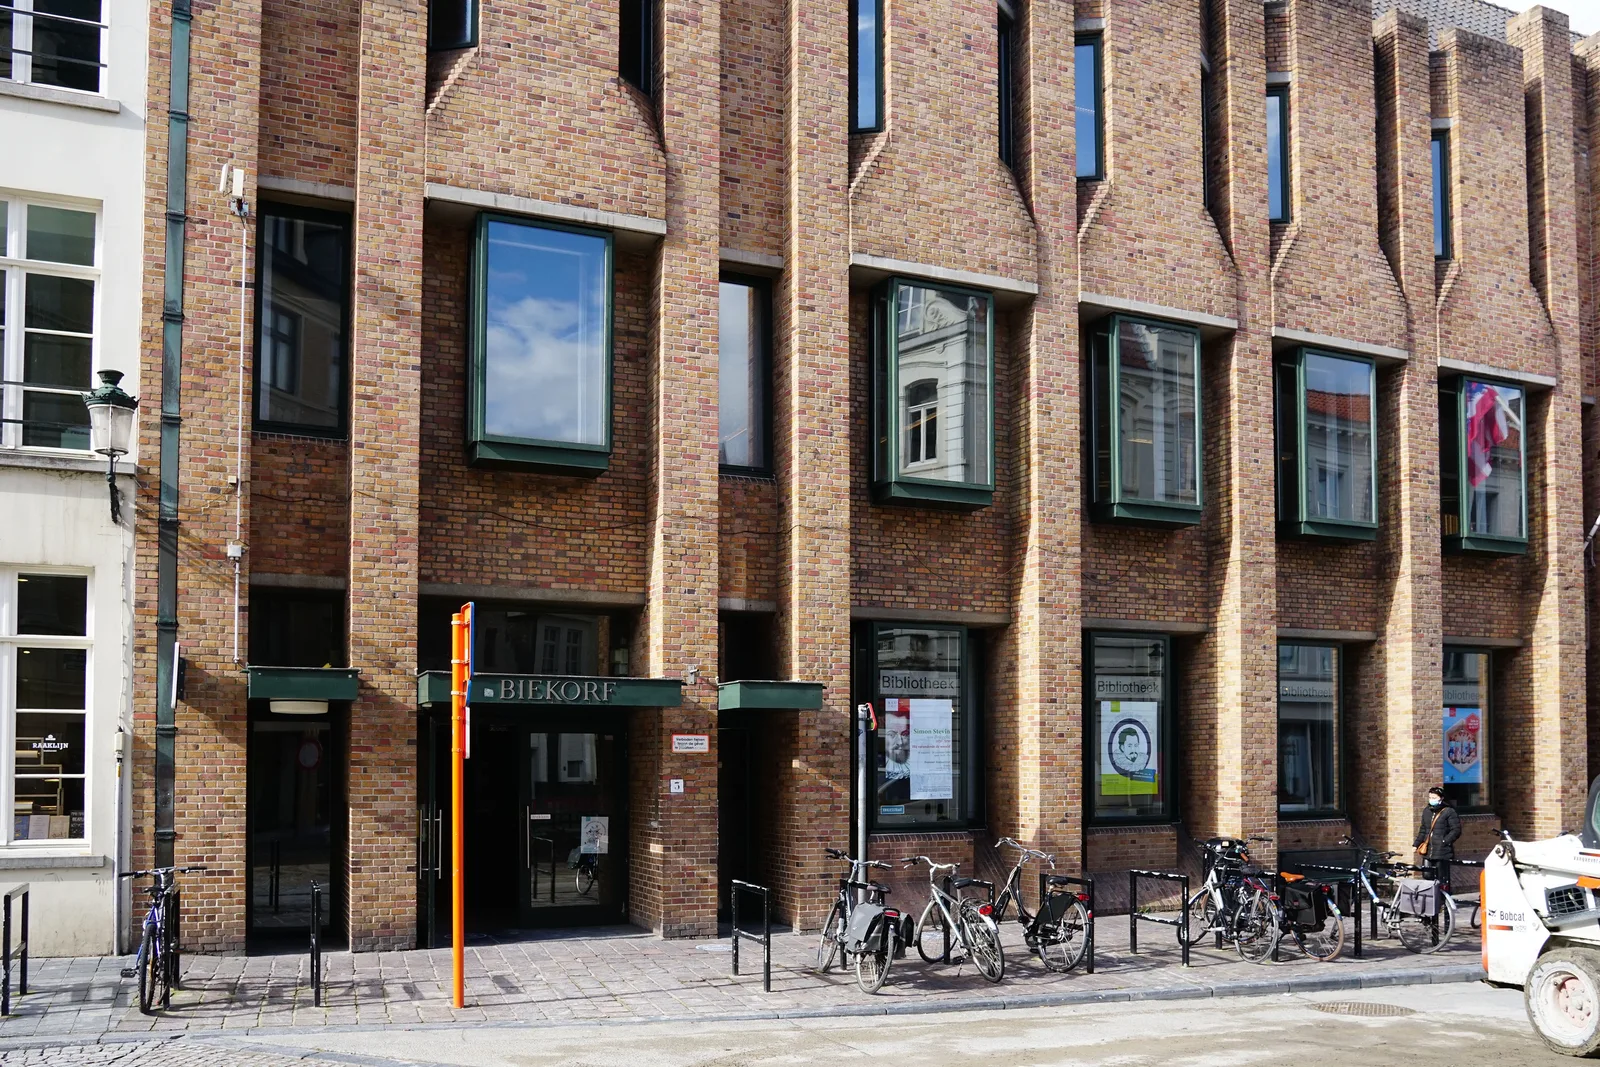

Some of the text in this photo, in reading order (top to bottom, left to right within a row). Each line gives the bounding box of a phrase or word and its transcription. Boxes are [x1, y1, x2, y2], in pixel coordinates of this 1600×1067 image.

[882, 676, 955, 690] Bibliotheek
[1097, 681, 1160, 693] Bibliotheek
[500, 680, 617, 702] BIEKORF
[1500, 910, 1525, 921] Bobcat
